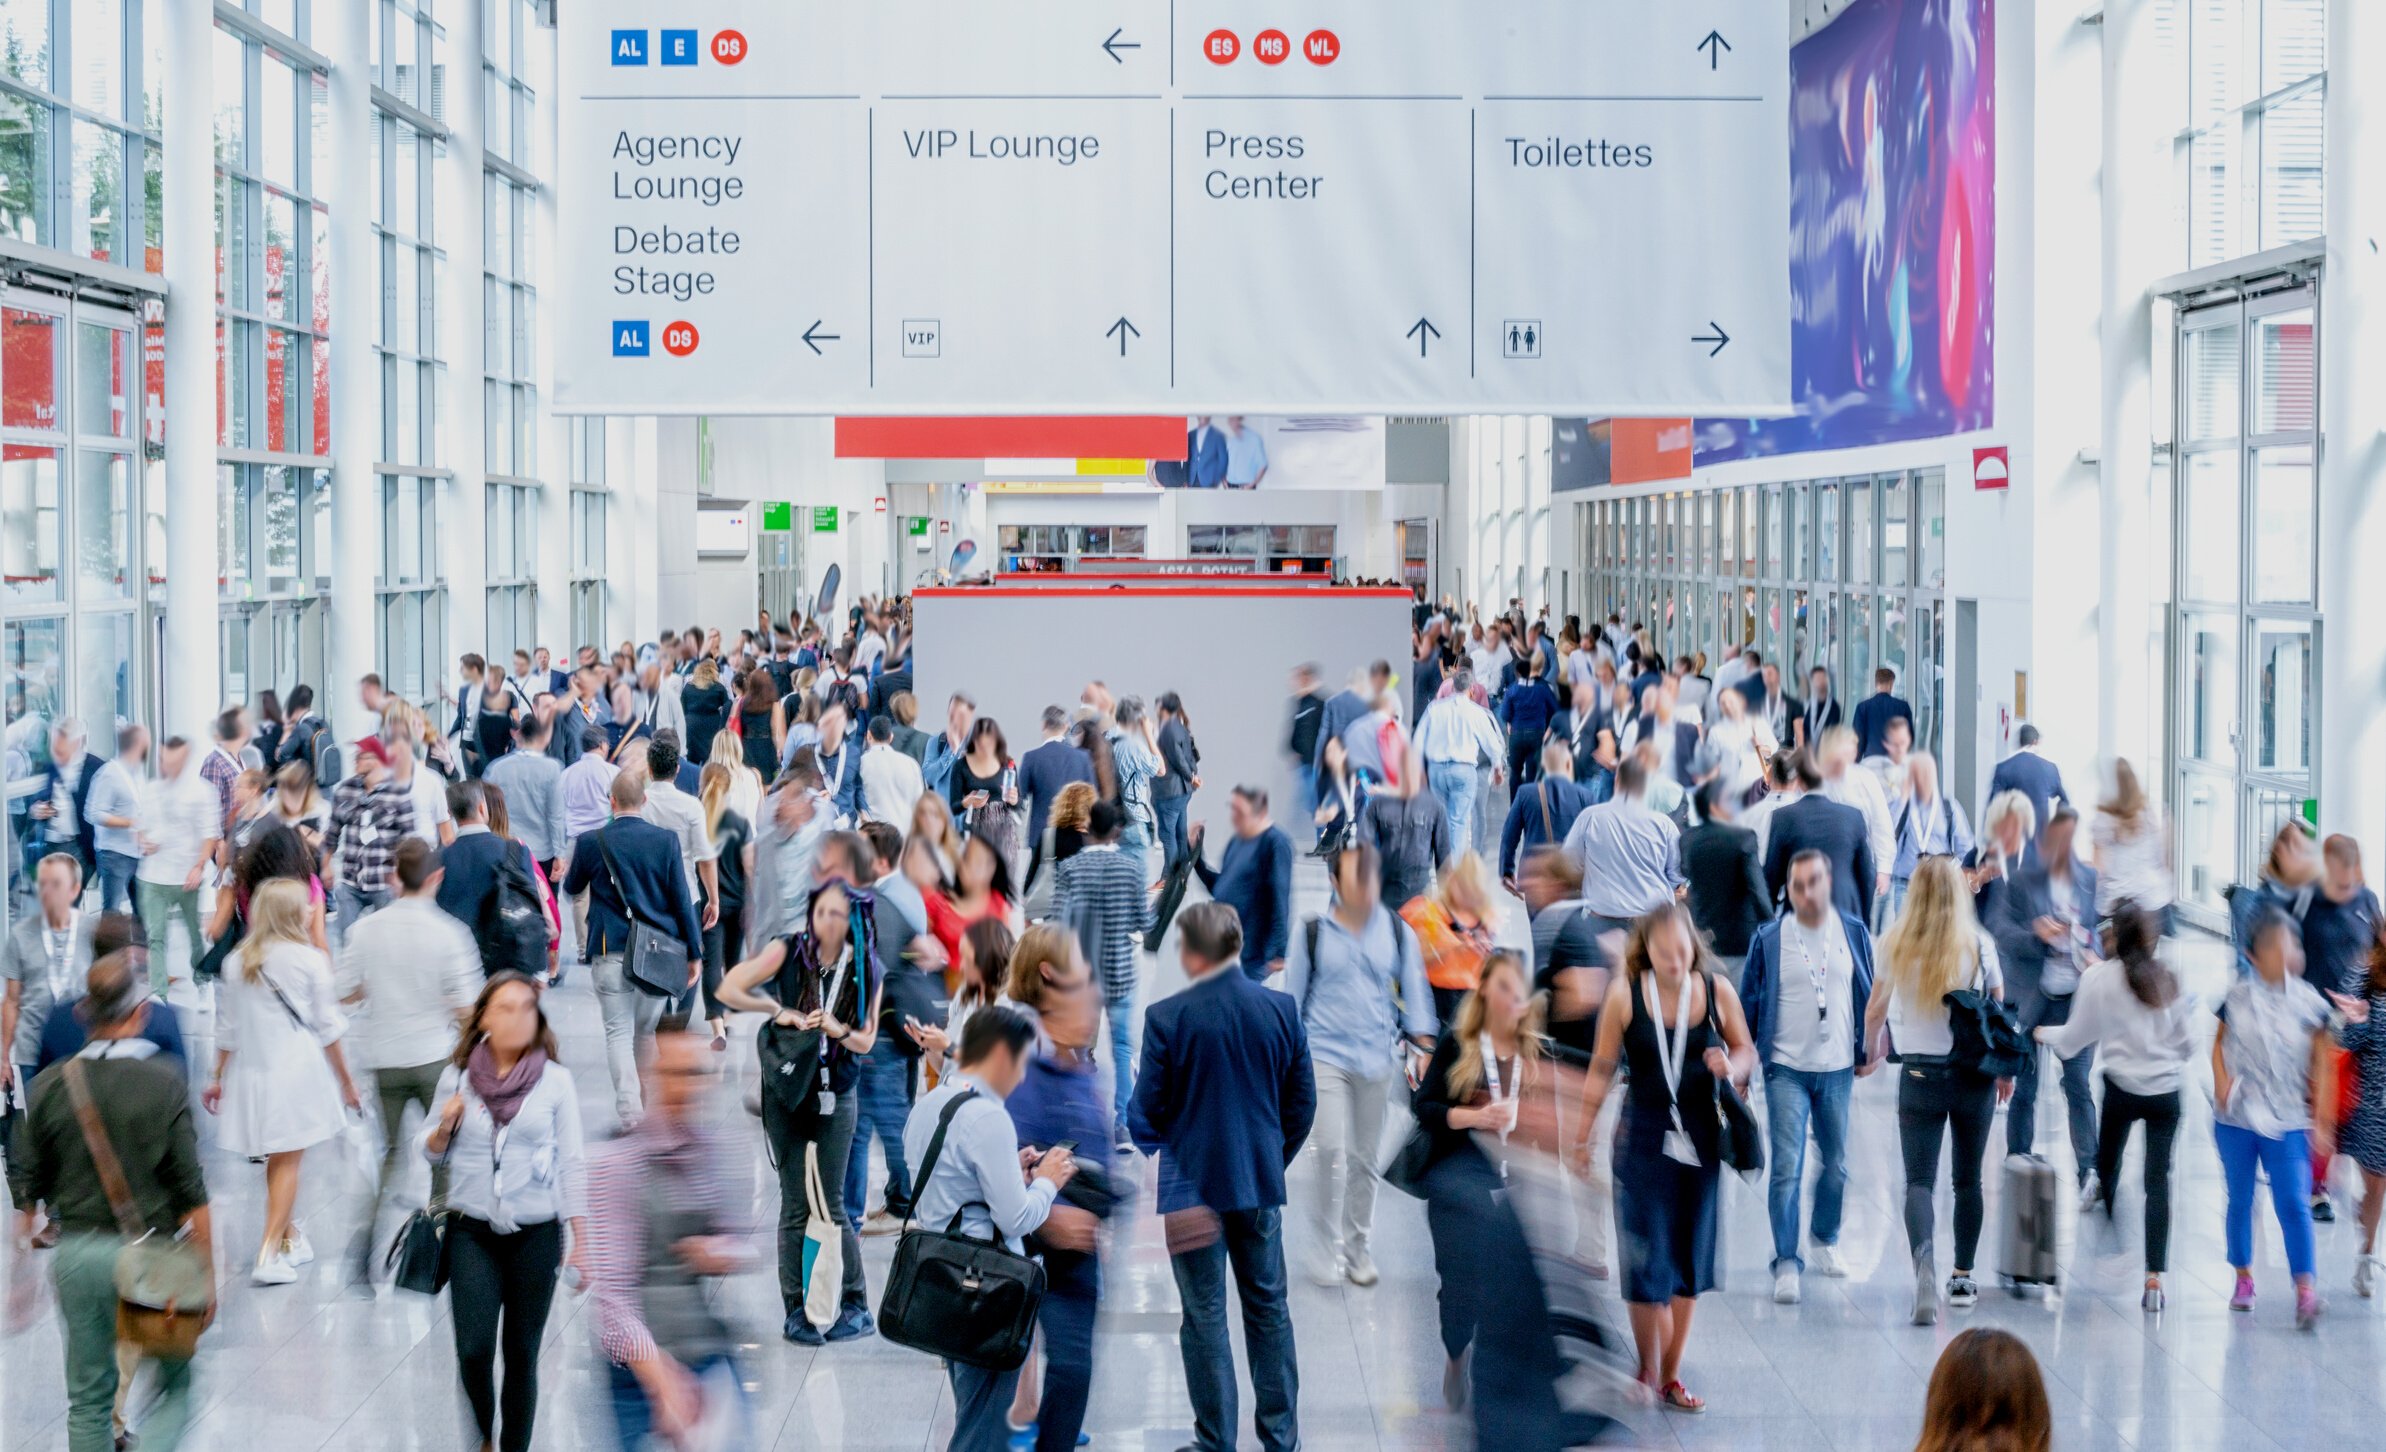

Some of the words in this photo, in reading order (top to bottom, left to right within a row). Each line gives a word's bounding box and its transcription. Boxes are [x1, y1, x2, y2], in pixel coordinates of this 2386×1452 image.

[617, 39, 641, 57] AL
[674, 39, 685, 57] E
[718, 39, 740, 57] DS
[1211, 38, 1234, 57] ES
[1260, 38, 1283, 57] MS
[1310, 38, 1333, 57] WL
[613, 130, 742, 166] Agency
[903, 130, 957, 159] VIP
[969, 130, 1100, 166] Lounge
[1205, 129, 1305, 159] Press
[1505, 137, 1653, 168] Toilettes
[614, 171, 743, 207] Lounge
[1205, 169, 1324, 200] Center
[614, 225, 741, 255] Debate
[613, 265, 715, 302] Stage
[619, 331, 643, 348] AL
[669, 331, 693, 348] DS
[907, 331, 935, 346] VIP
